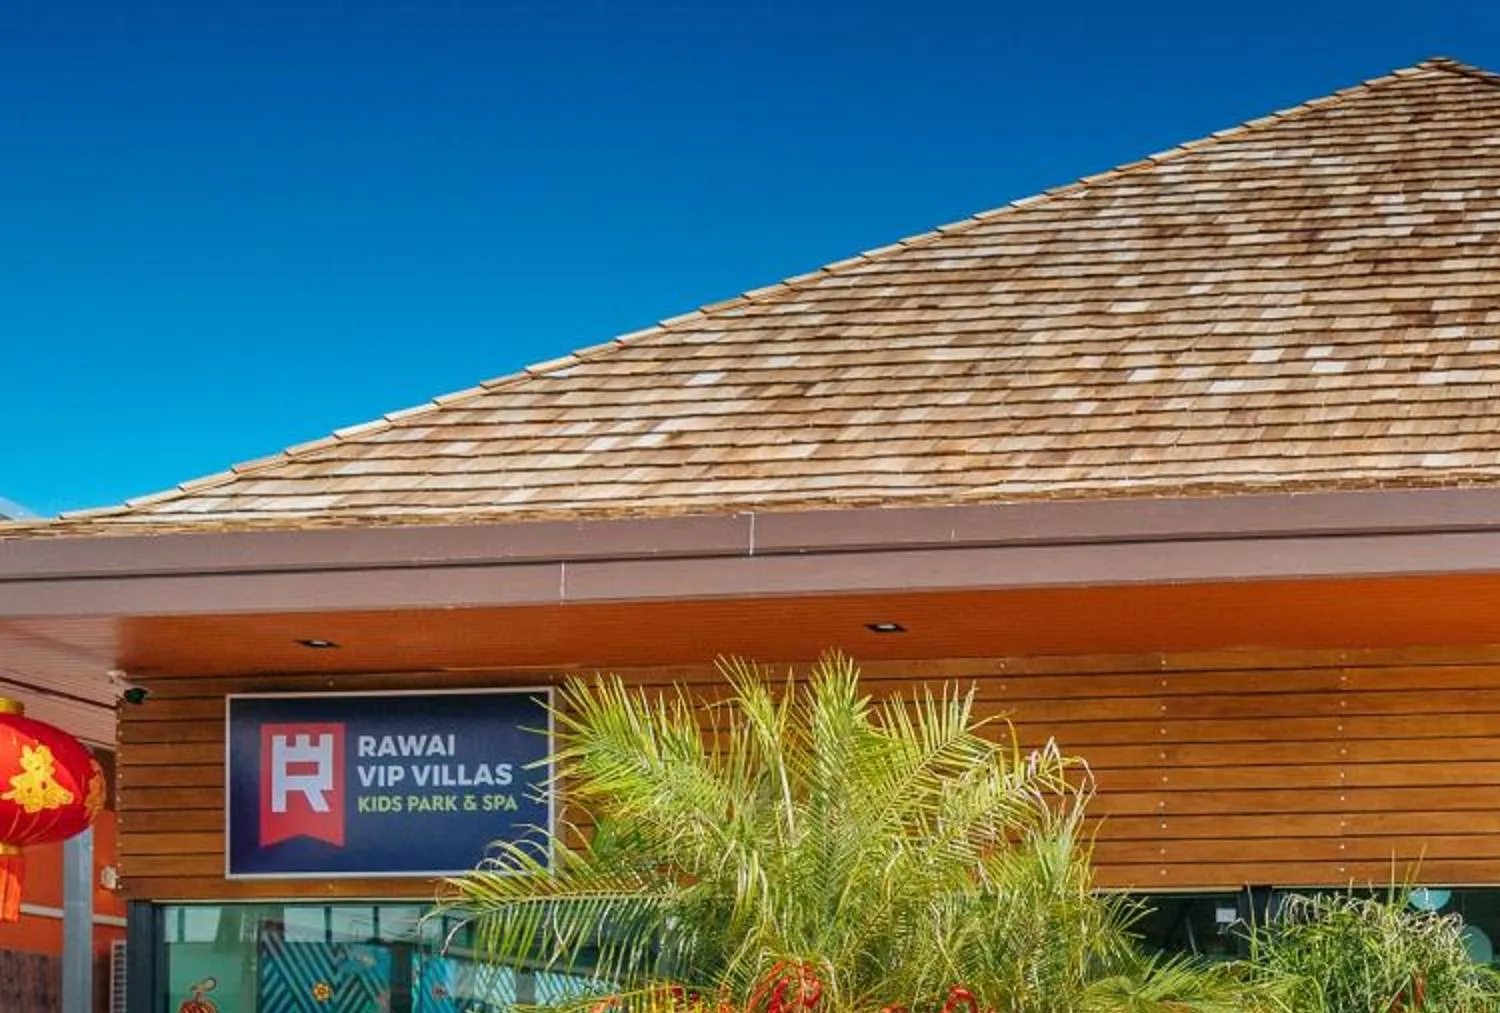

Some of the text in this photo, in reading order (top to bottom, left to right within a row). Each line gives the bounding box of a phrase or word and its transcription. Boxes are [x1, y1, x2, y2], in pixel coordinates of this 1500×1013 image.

[357, 734, 455, 757] RAWAI
[357, 764, 513, 787] VIP VILLAS
[358, 794, 518, 813] KIDS PARK & SPA
